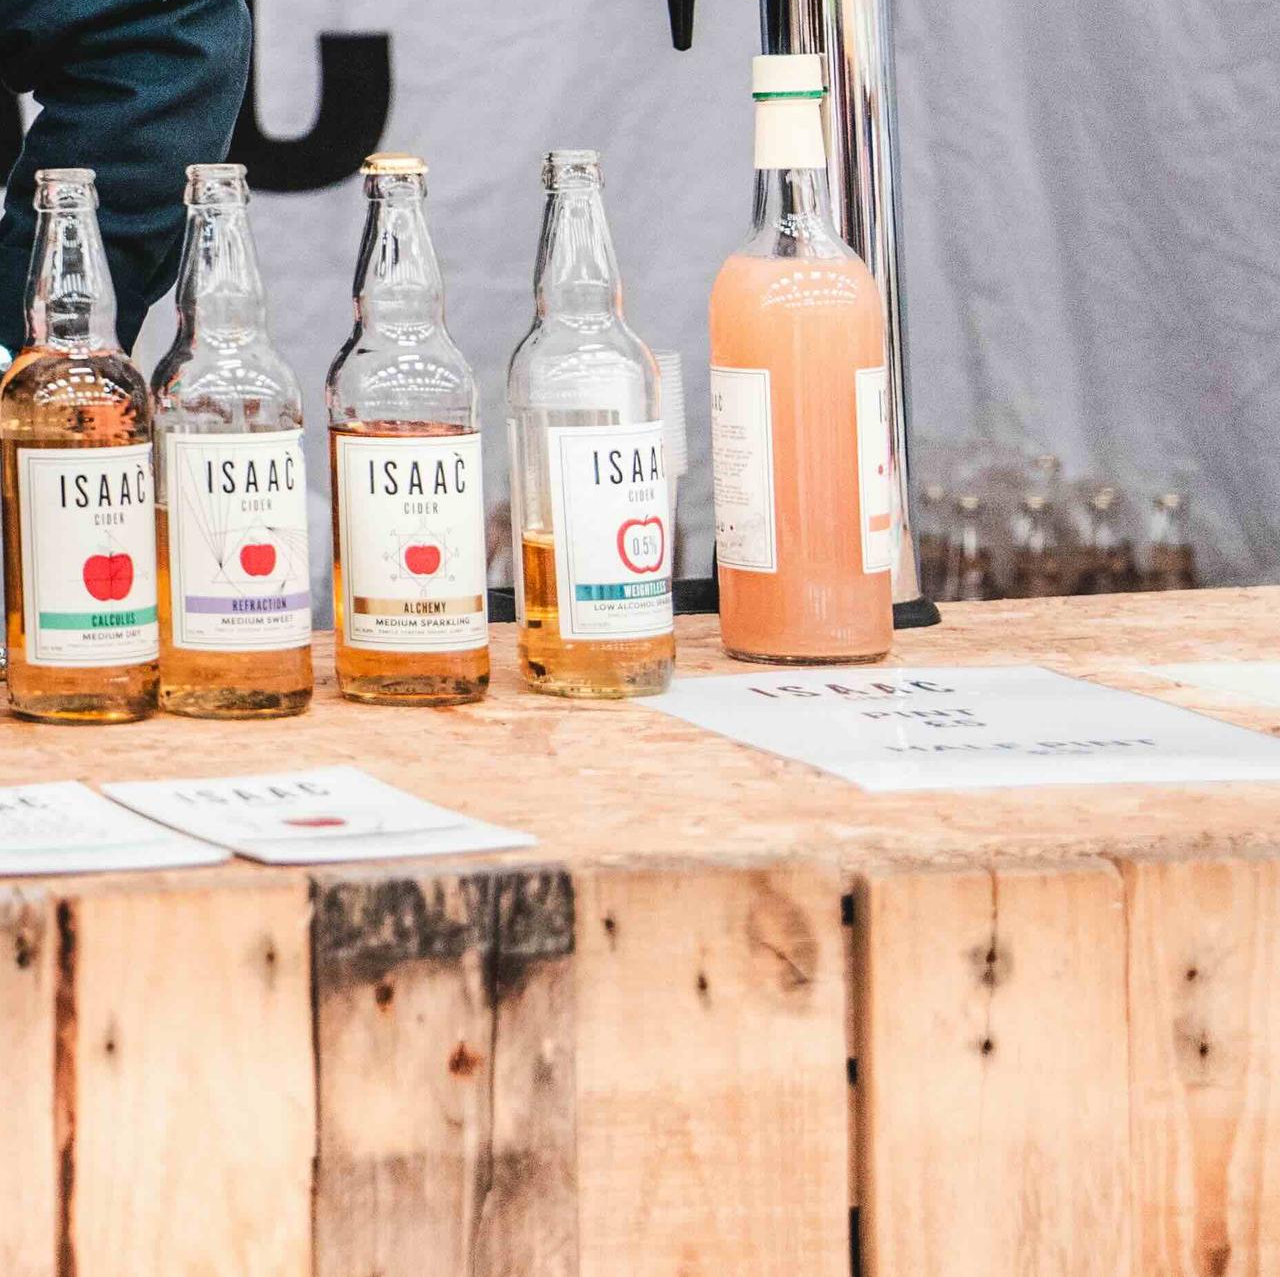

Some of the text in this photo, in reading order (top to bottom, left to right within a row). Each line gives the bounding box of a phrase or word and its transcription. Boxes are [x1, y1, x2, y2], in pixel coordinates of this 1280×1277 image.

[593, 440, 666, 485] ISAA
[207, 452, 295, 494] ISAAC
[369, 452, 466, 496] ISAAC
[60, 464, 146, 508] ISAAC
[241, 499, 273, 512] CIDER
[404, 502, 439, 515] CIDER
[94, 512, 125, 526] CIDER
[623, 580, 667, 599] WEIGHTLESS
[232, 597, 287, 612] REFRACTION
[403, 601, 447, 614] ALCHEMY
[594, 603, 615, 611] LOW
[617, 601, 655, 610] ALCOHOL
[91, 612, 136, 627] CALCULUS
[221, 614, 294, 625] MEDIUM SWEET
[375, 616, 471, 627] MEDIUM SPARKLING
[82, 630, 141, 641] MEDIUM DRY
[746, 680, 955, 698] ISAAC
[861, 709, 974, 719] PINT
[1036, 738, 1157, 748] PINT
